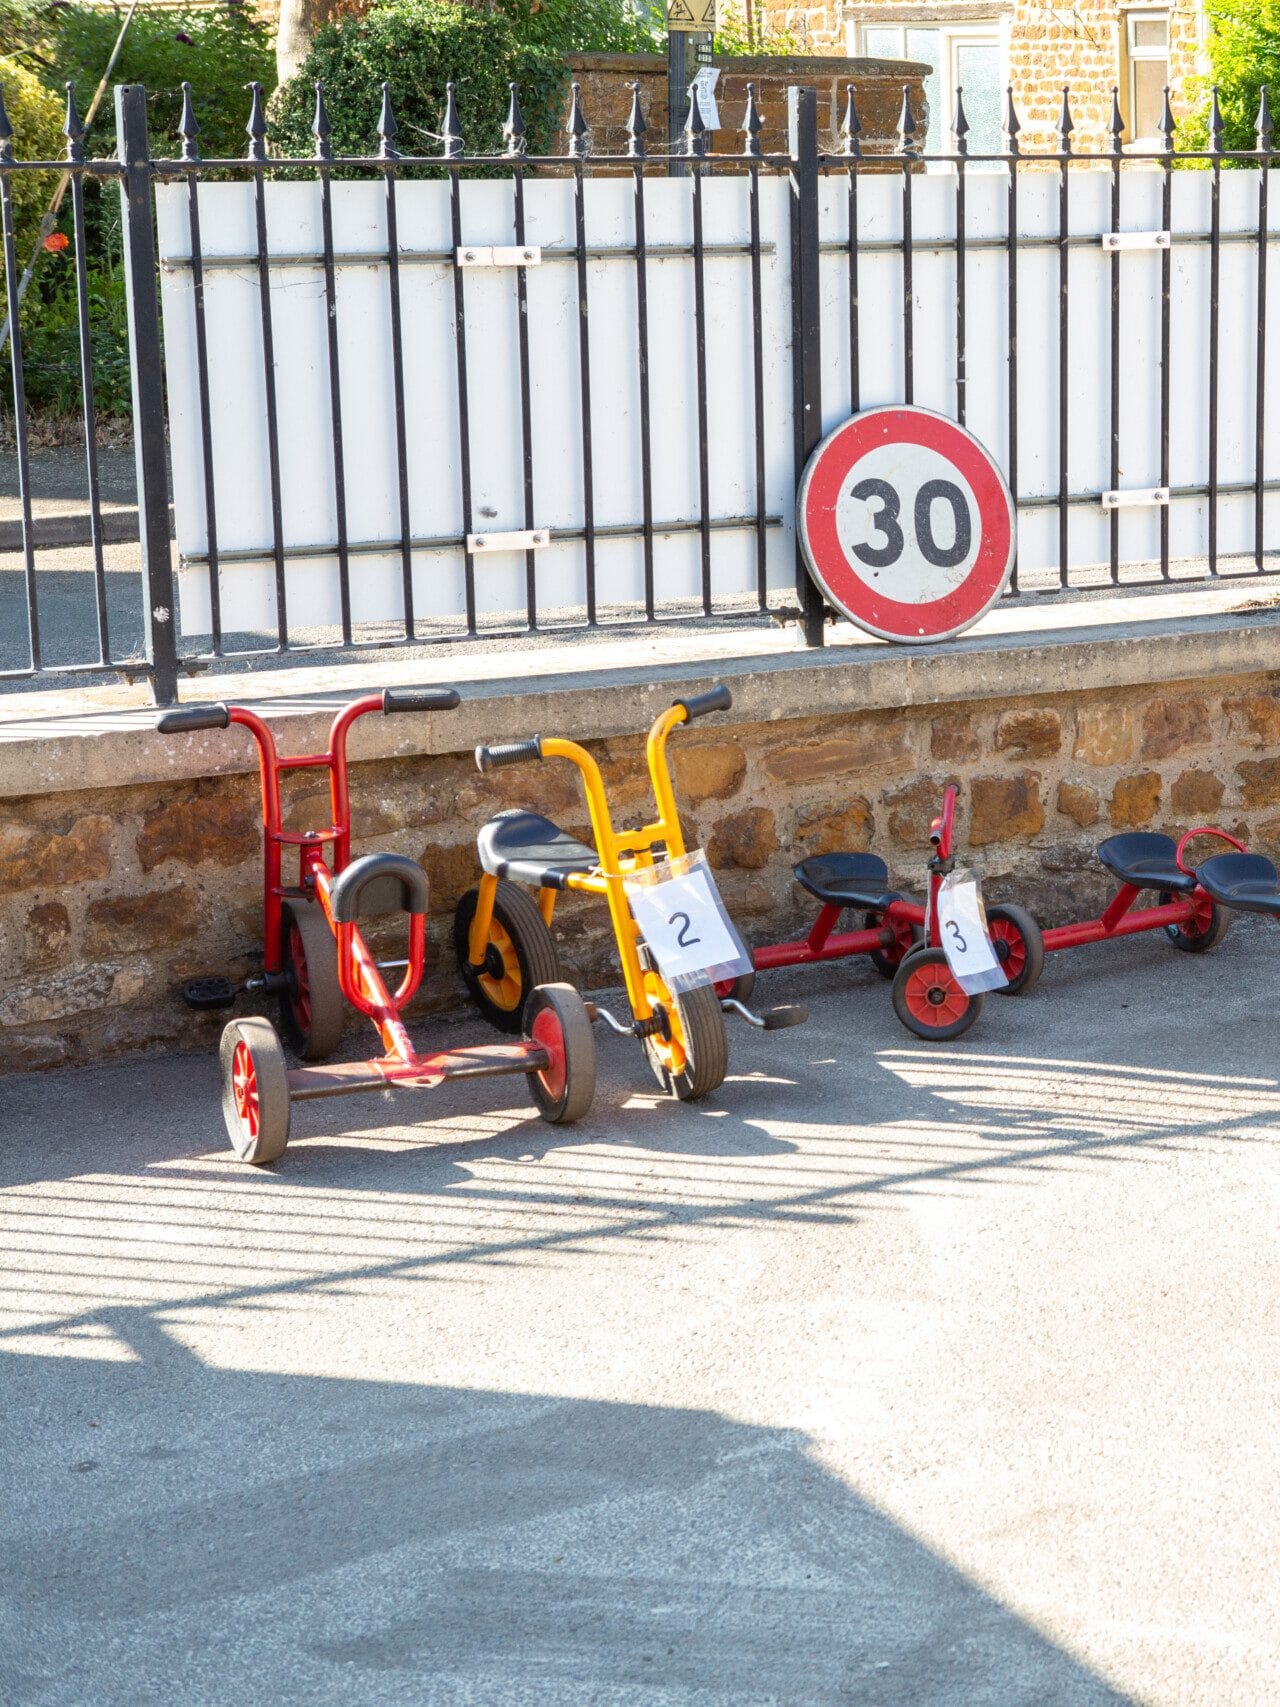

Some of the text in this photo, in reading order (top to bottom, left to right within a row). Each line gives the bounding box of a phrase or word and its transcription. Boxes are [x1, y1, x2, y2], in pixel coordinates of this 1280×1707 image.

[850, 478, 972, 568] 30
[668, 911, 701, 948] 2
[945, 920, 967, 953] 3
